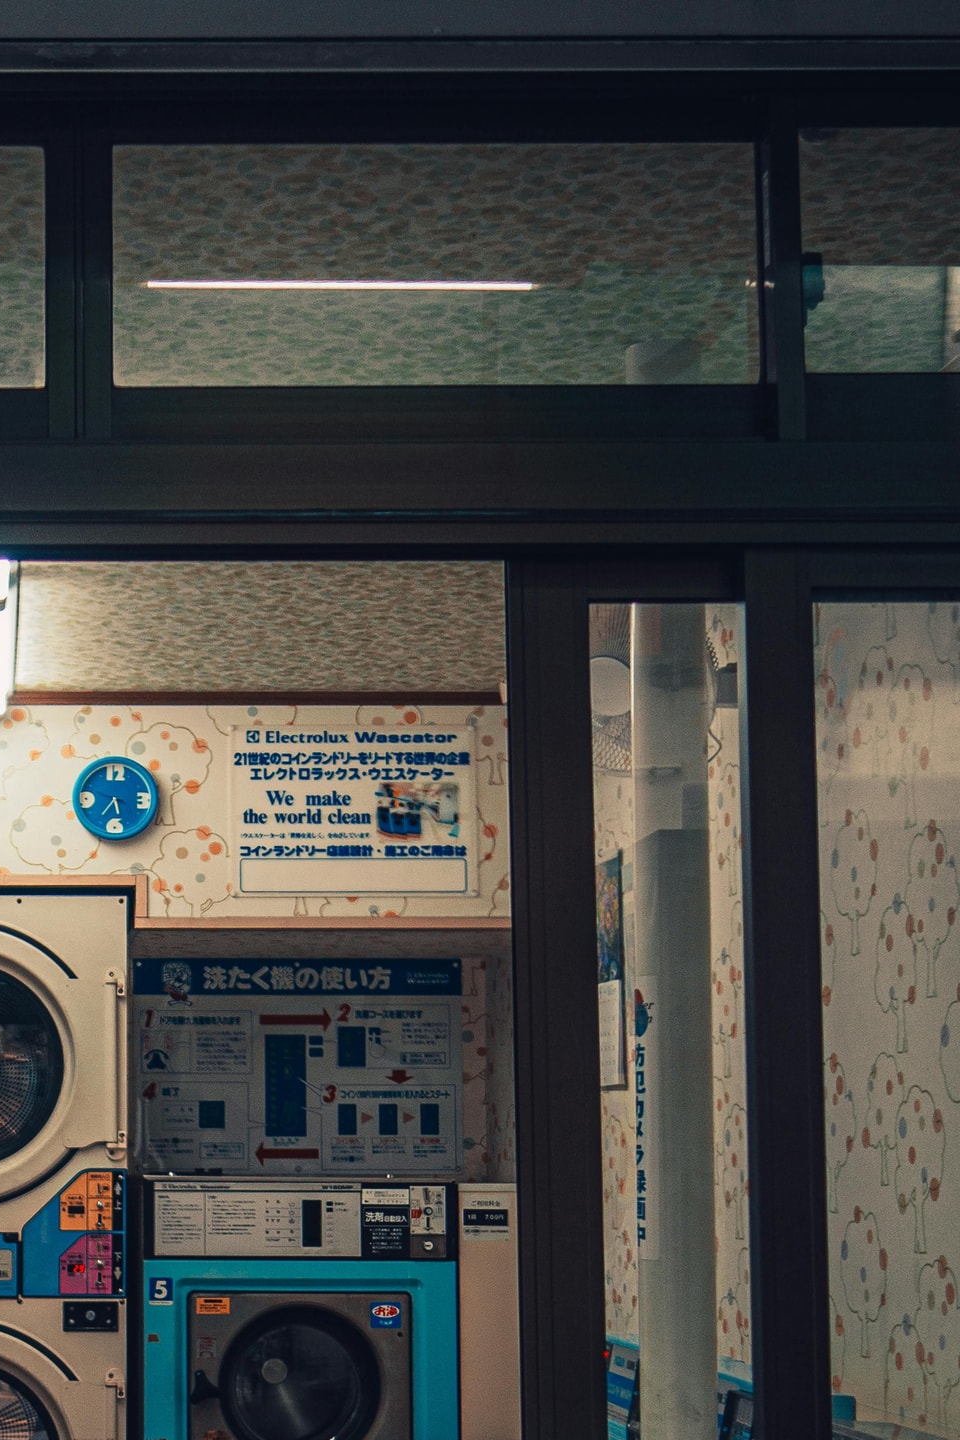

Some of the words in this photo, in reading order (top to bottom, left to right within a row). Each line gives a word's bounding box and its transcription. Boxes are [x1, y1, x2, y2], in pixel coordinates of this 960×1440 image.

[265, 731, 349, 744] Electrolux
[354, 731, 458, 744] Wascator
[106, 765, 125, 781] 12
[250, 767, 454, 781] エレクトロラックス・ウエスケーター
[81, 791, 96, 809] 9
[136, 792, 150, 810] 3
[266, 790, 294, 806] We
[305, 790, 351, 806] make
[243, 808, 268, 824] the
[274, 808, 322, 824] world
[327, 808, 371, 824] clean
[106, 818, 124, 834] 6
[203, 966, 392, 990] 洗たく機の使い方
[337, 1003, 352, 1022] 2
[323, 1084, 337, 1103] 3
[154, 1280, 168, 1300] 5
